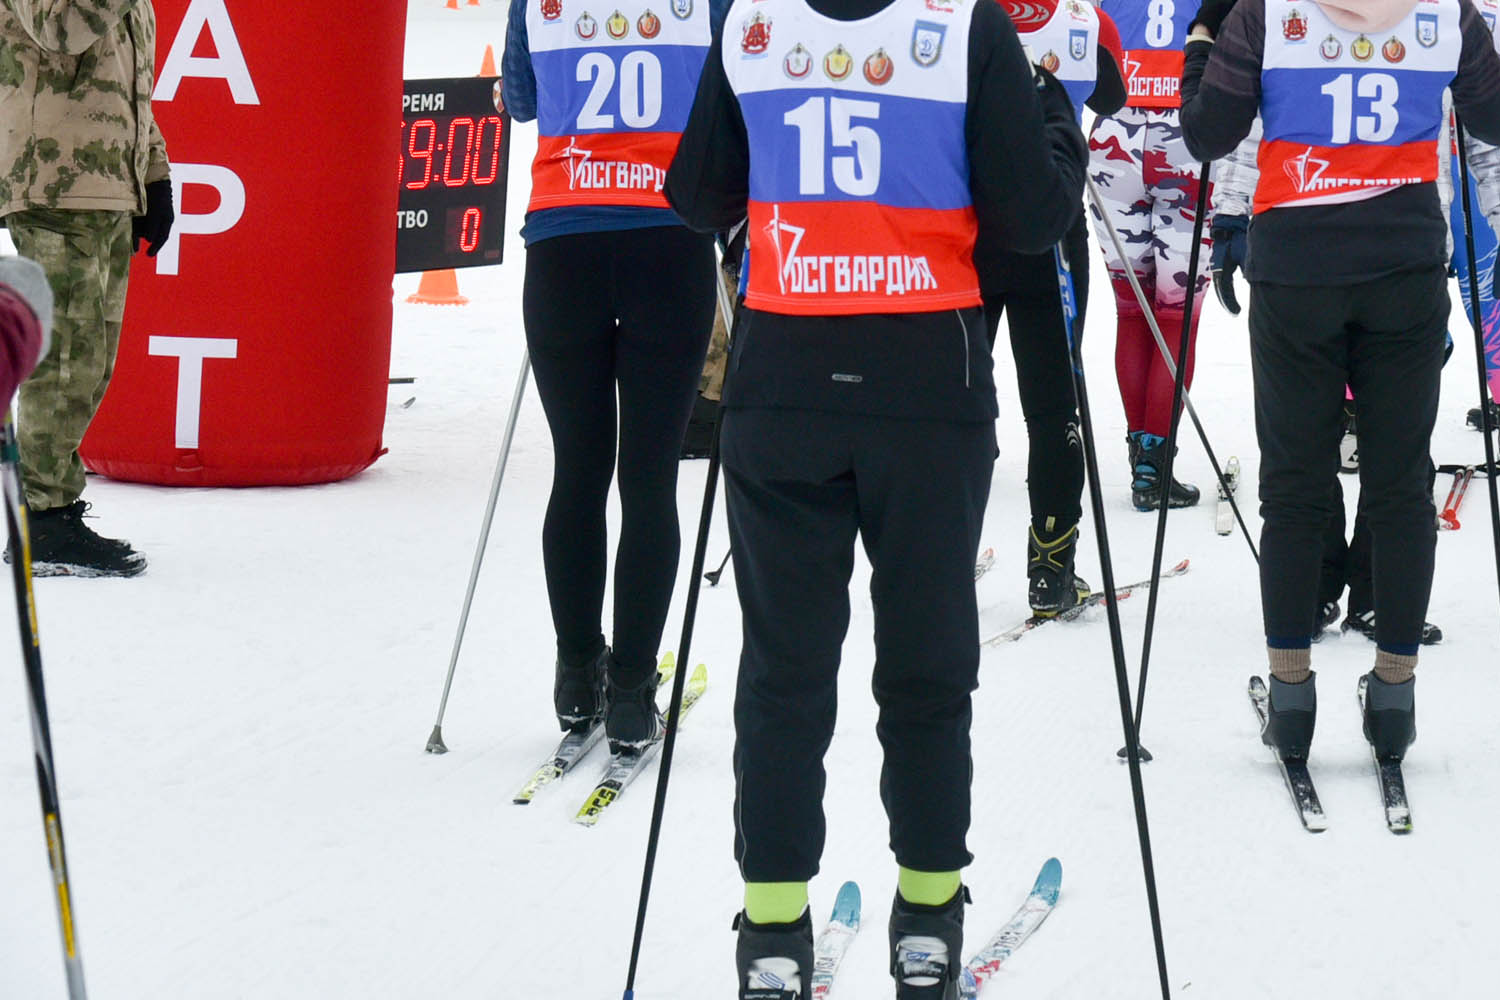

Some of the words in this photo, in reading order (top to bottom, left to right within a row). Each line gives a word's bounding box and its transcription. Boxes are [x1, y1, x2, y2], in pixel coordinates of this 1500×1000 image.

[403, 93, 446, 112] РЕМЯ
[574, 50, 663, 130] 20
[1121, 50, 1181, 97] РОСГВАР
[1321, 72, 1400, 144] 13
[399, 116, 503, 190] 9:00
[558, 136, 668, 192] РОСГВАРД
[783, 96, 882, 197] 15
[460, 208, 481, 252] 0
[764, 203, 938, 296] РОСГВАРДИЯ
